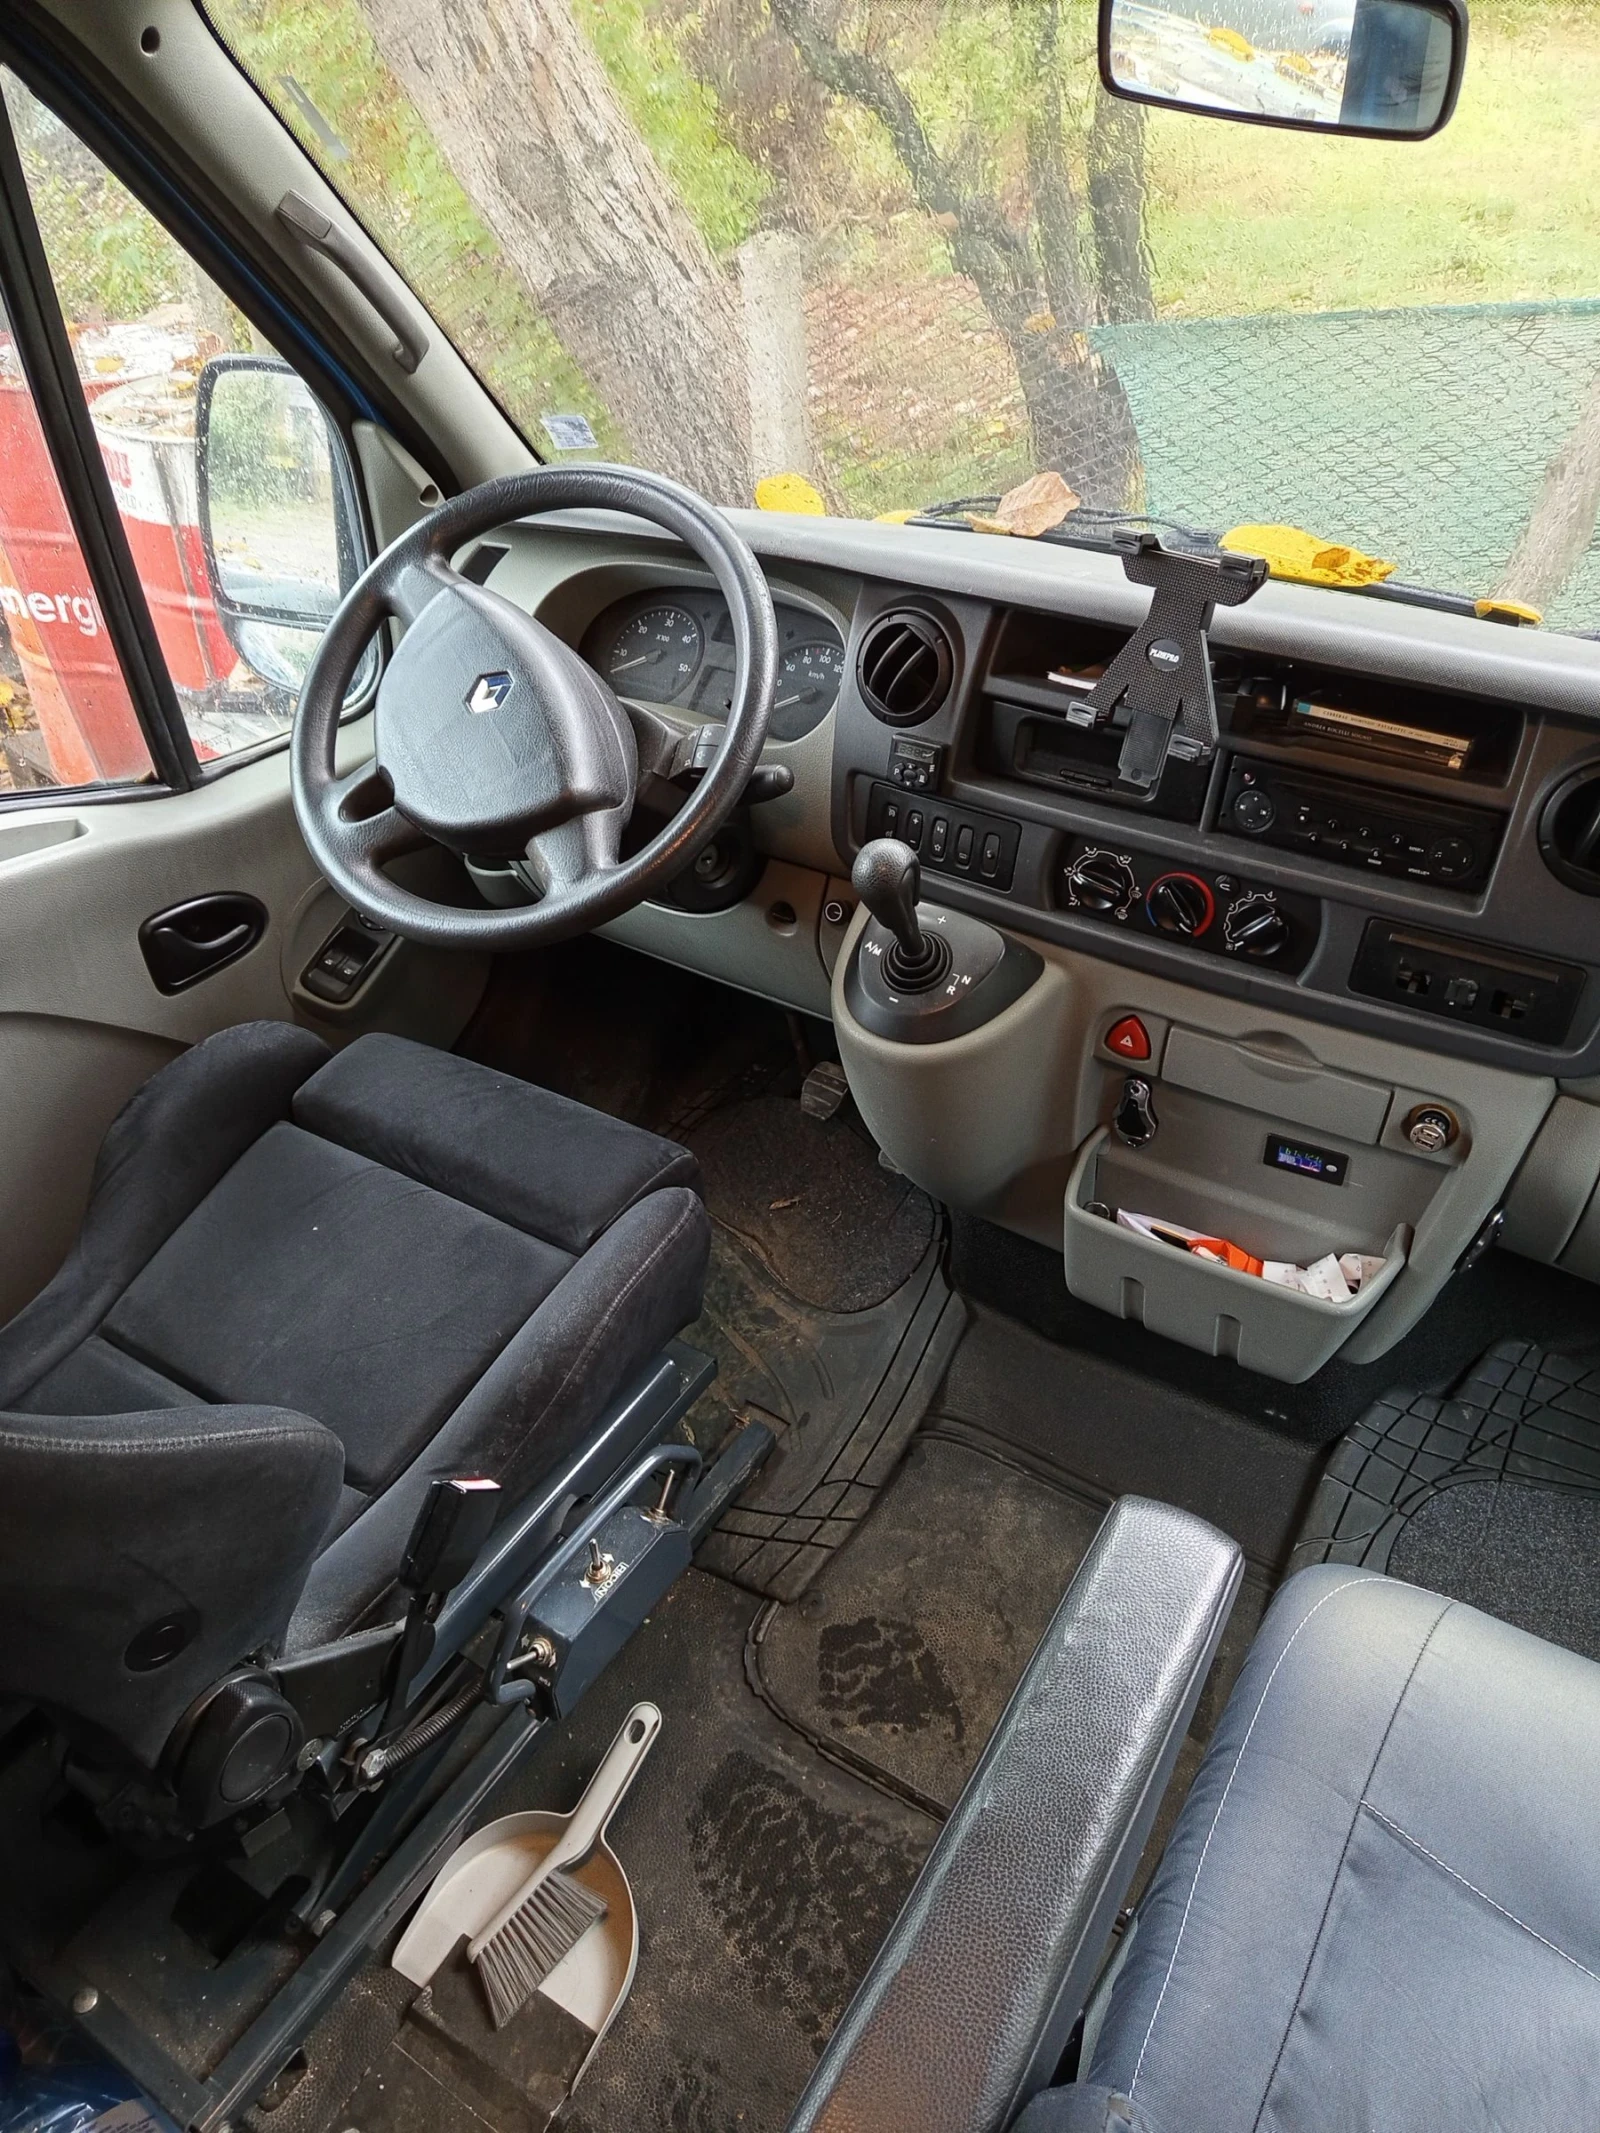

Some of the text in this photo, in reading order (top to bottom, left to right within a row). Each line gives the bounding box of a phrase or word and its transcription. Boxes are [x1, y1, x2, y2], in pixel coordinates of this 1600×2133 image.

[0, 585, 106, 637] nerg
[664, 618, 674, 627] 30
[638, 625, 648, 634] 20
[682, 635, 692, 644] 40
[802, 655, 812, 665] 80
[819, 655, 832, 664] 100
[678, 663, 689, 672] 50
[786, 664, 796, 672] 60
[808, 670, 825, 680] km/h
[865, 940, 882, 957] A/M
[961, 975, 972, 985] N
[946, 986, 955, 996] R
